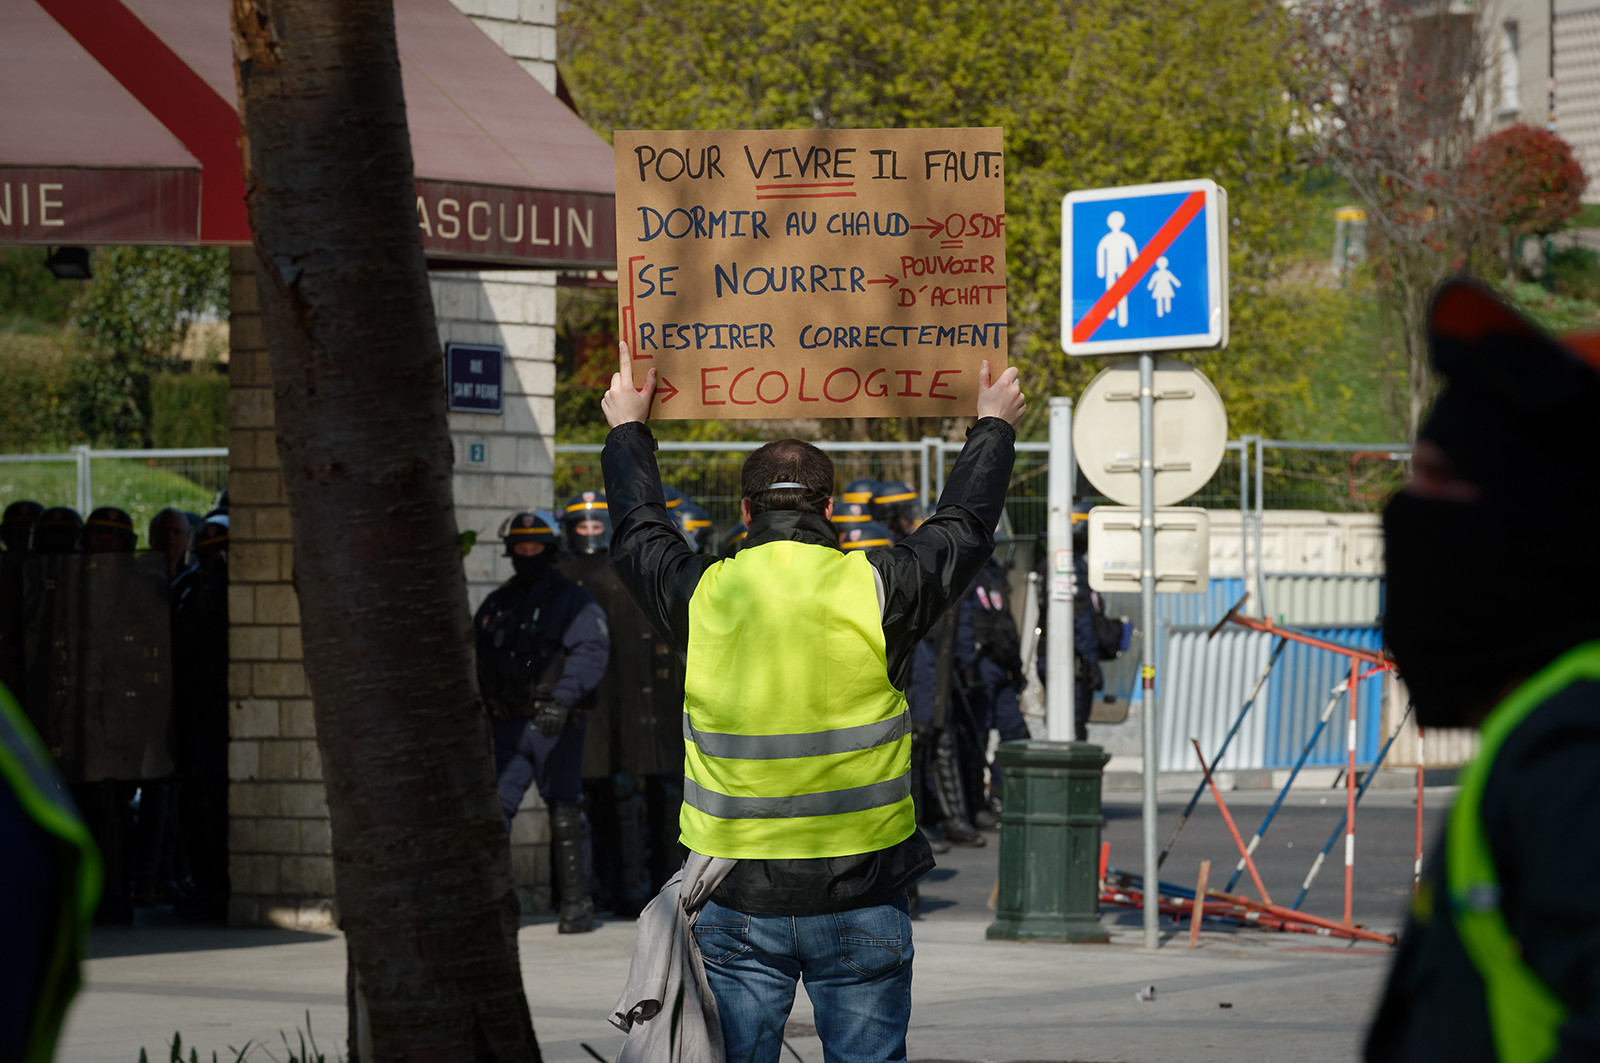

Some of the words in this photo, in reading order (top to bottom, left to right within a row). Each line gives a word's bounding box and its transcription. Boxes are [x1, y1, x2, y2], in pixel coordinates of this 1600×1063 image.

[634, 145, 726, 182] POUR
[744, 145, 856, 180] VIVRE
[869, 149, 907, 180] IL
[925, 149, 1002, 182] FAUT:
[637, 206, 770, 242] DORMIR
[786, 211, 817, 237] AU
[827, 211, 910, 237] CHAUD
[637, 263, 679, 299] SE
[715, 262, 866, 297] NOURRIR
[900, 255, 995, 279] POUVOIR
[639, 322, 776, 350] RESPIRER
[799, 322, 1007, 350] CORRECTEMENT
[700, 366, 962, 406] ECOLOGIE
